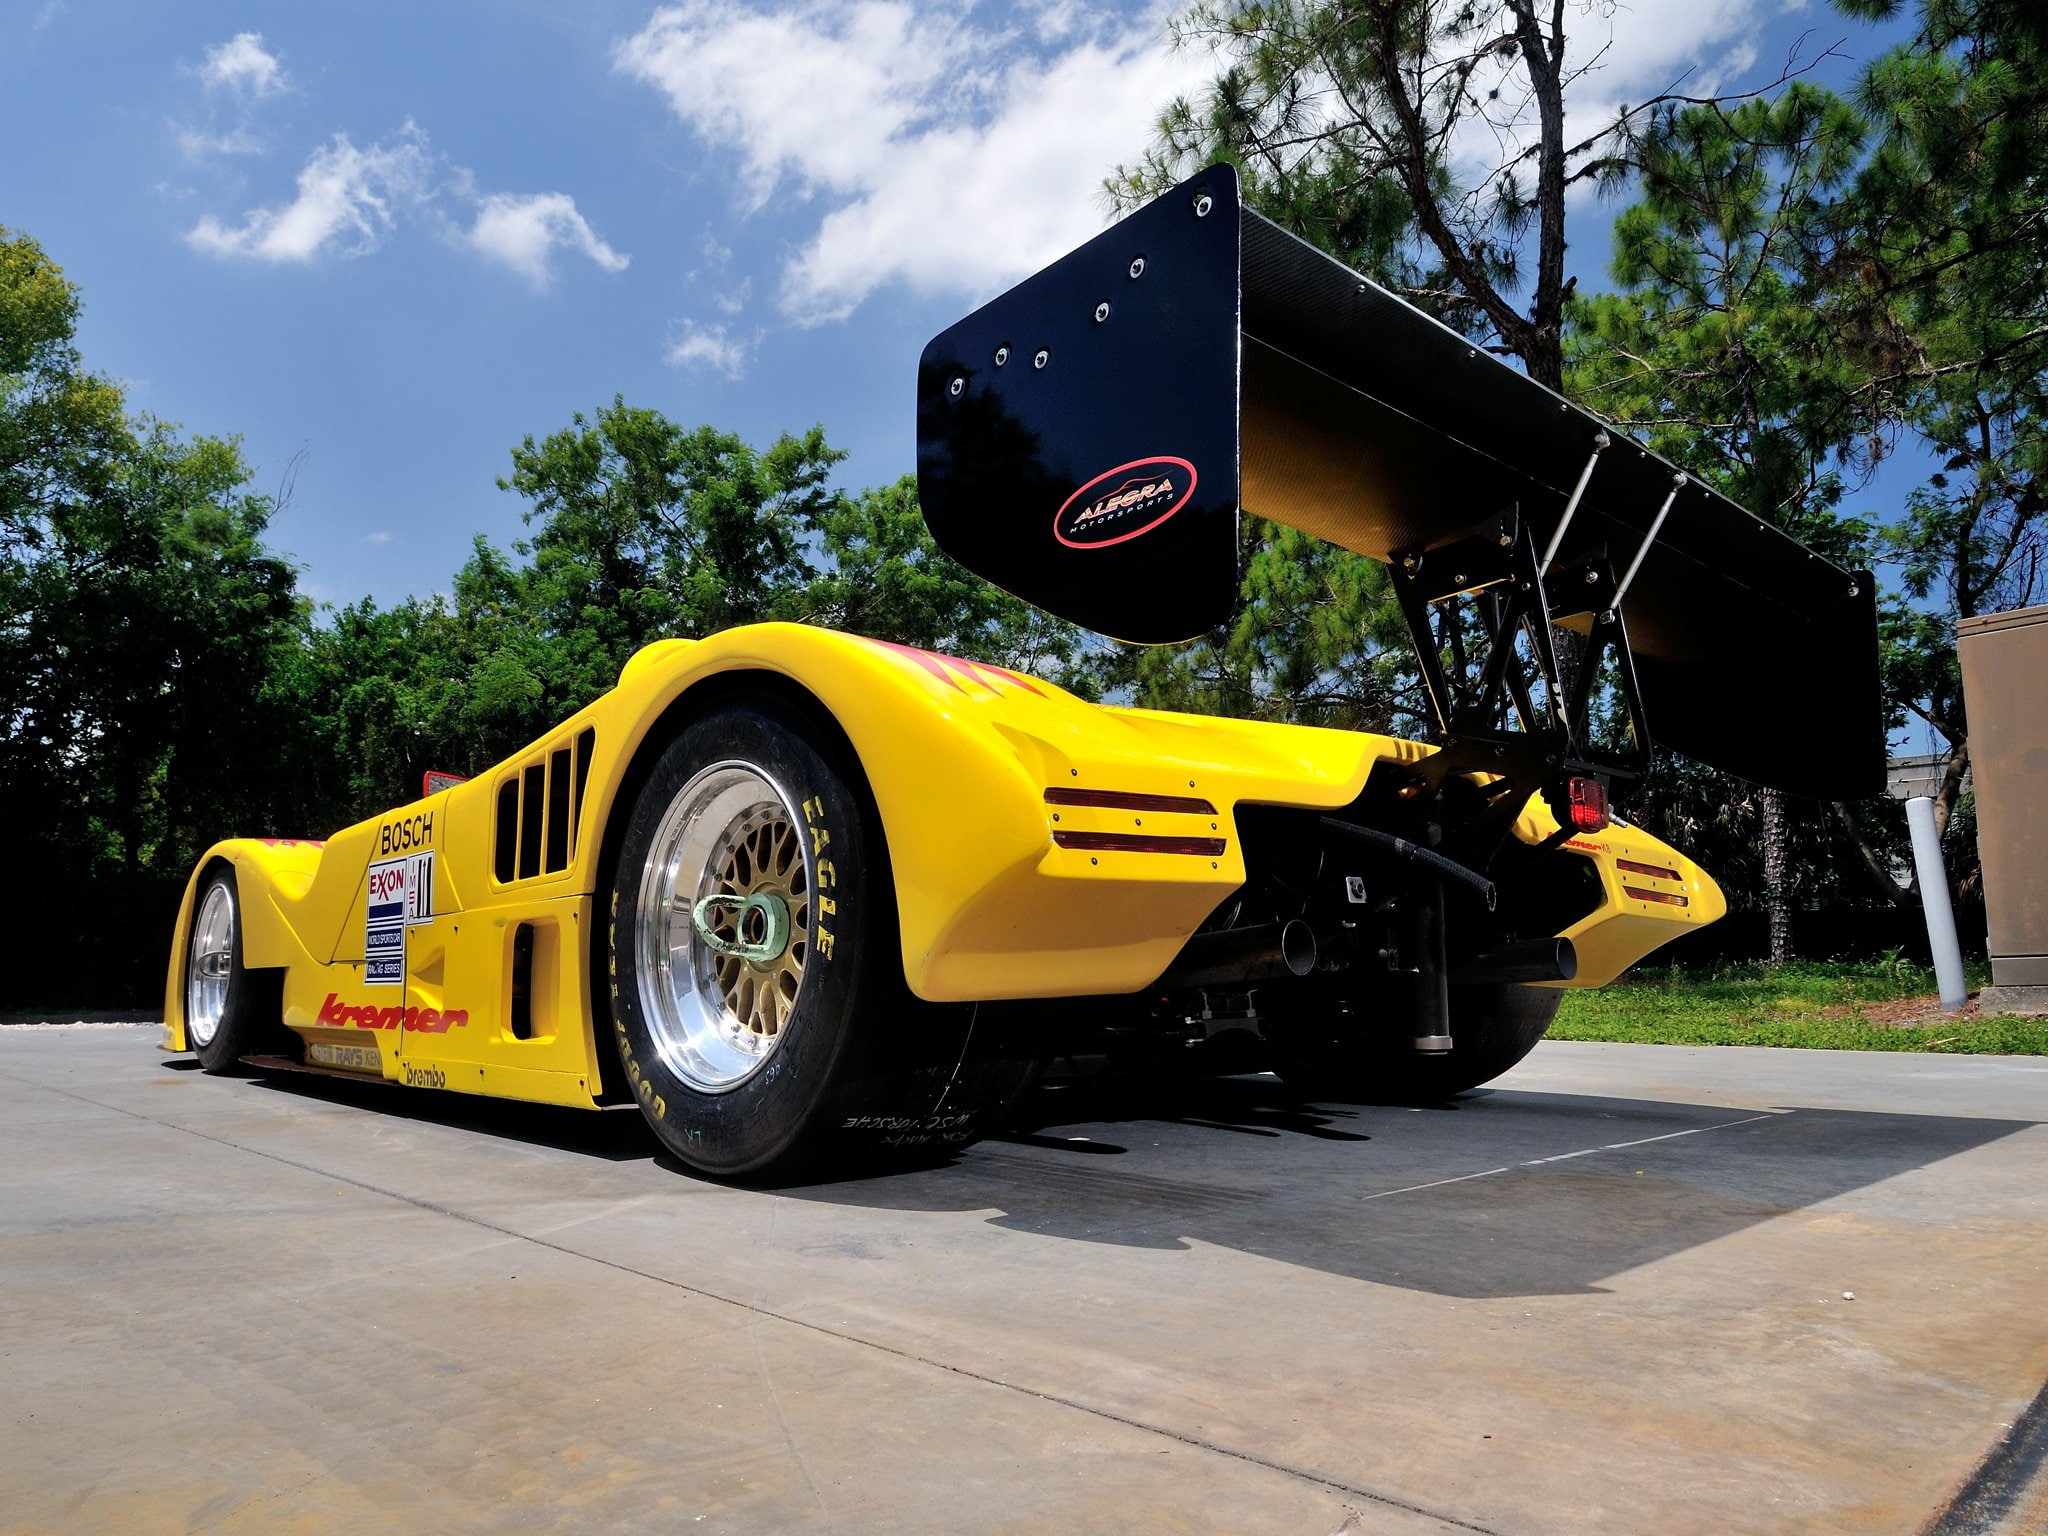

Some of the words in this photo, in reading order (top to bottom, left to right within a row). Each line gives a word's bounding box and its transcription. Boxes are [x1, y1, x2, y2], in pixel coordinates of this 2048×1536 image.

[1069, 492, 1174, 534] MOTORSPORTS
[1074, 478, 1173, 524] ALEGRA
[381, 811, 434, 856] BOSCH
[1547, 831, 1602, 851] emer
[369, 868, 405, 901] EXXON
[408, 860, 417, 921] IMSA
[802, 795, 837, 961] EAGLE
[384, 963, 400, 974] SERIES
[315, 993, 469, 1034] kremer
[336, 1047, 363, 1066] RAYS
[406, 1062, 446, 1089] brembo
[683, 1127, 703, 1149] LR
